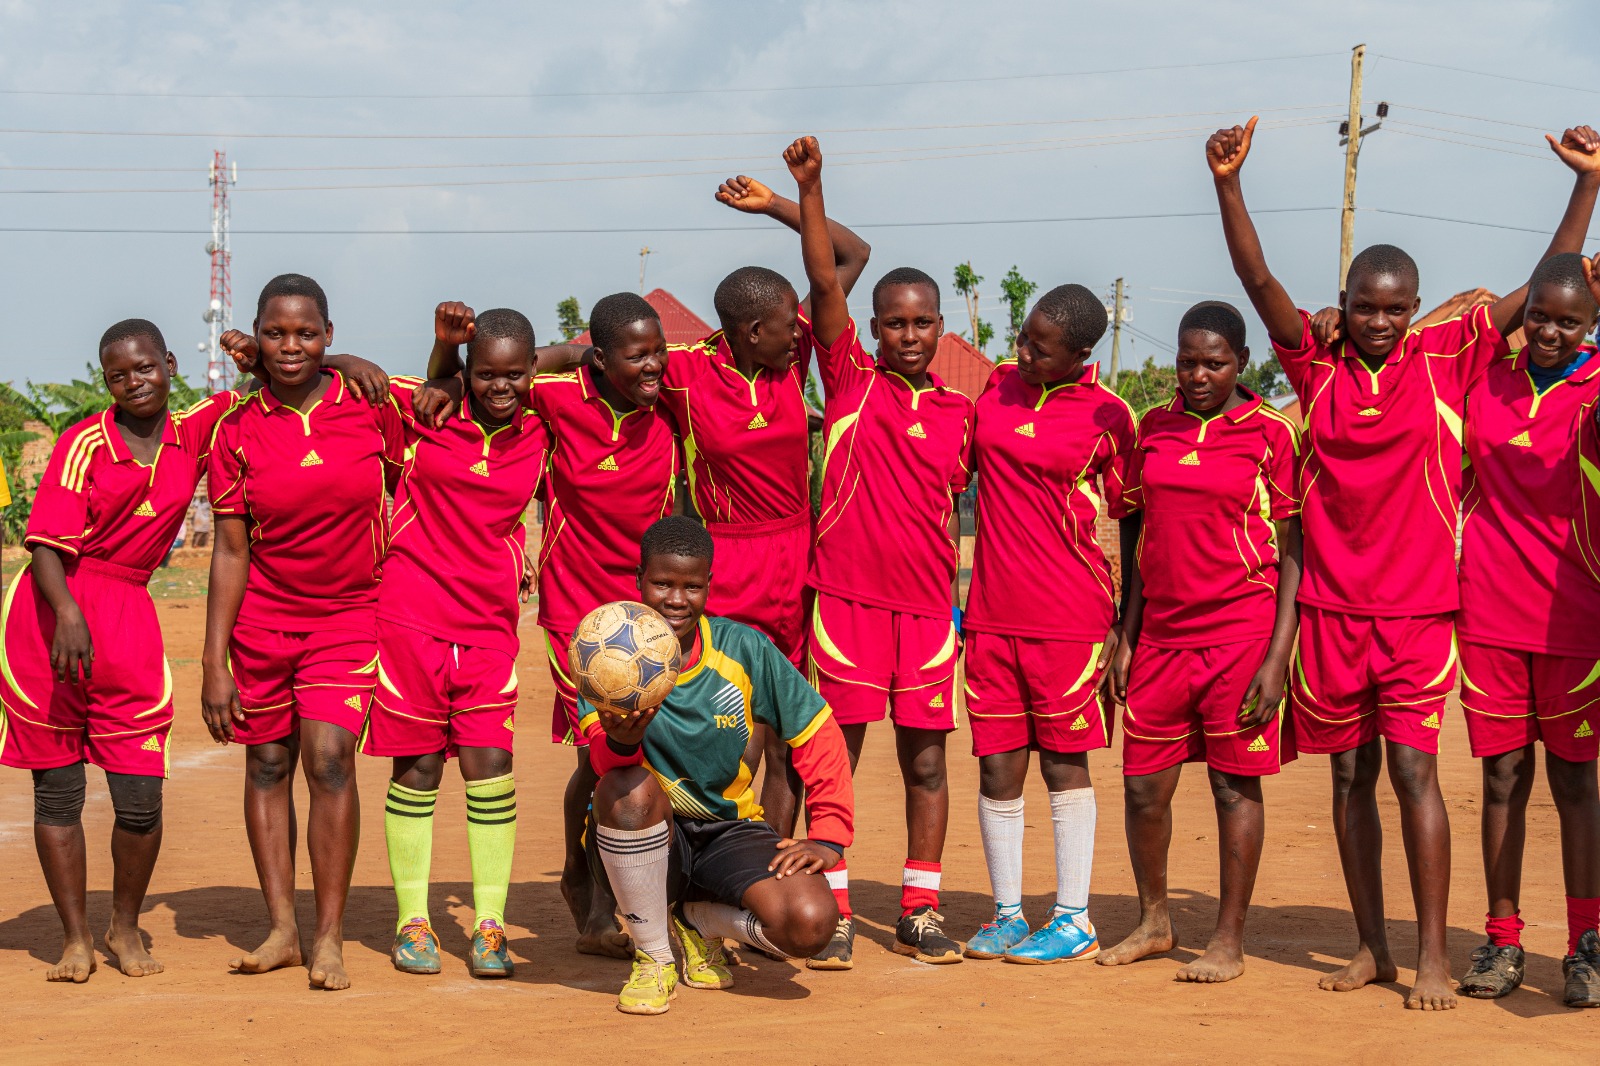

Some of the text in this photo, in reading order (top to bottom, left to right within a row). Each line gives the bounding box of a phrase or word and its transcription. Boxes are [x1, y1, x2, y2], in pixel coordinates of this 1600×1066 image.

[748, 421, 768, 430] adidas
[1014, 427, 1036, 438] adidas
[1508, 439, 1532, 448] adidas
[300, 459, 324, 467] adidas
[469, 466, 490, 478] adidas
[597, 464, 619, 472] adidas
[713, 714, 737, 729] T90
[1421, 720, 1440, 730] adidas
[1070, 722, 1089, 731] adidas
[1573, 729, 1594, 738] adidas
[141, 744, 161, 753] adidas
